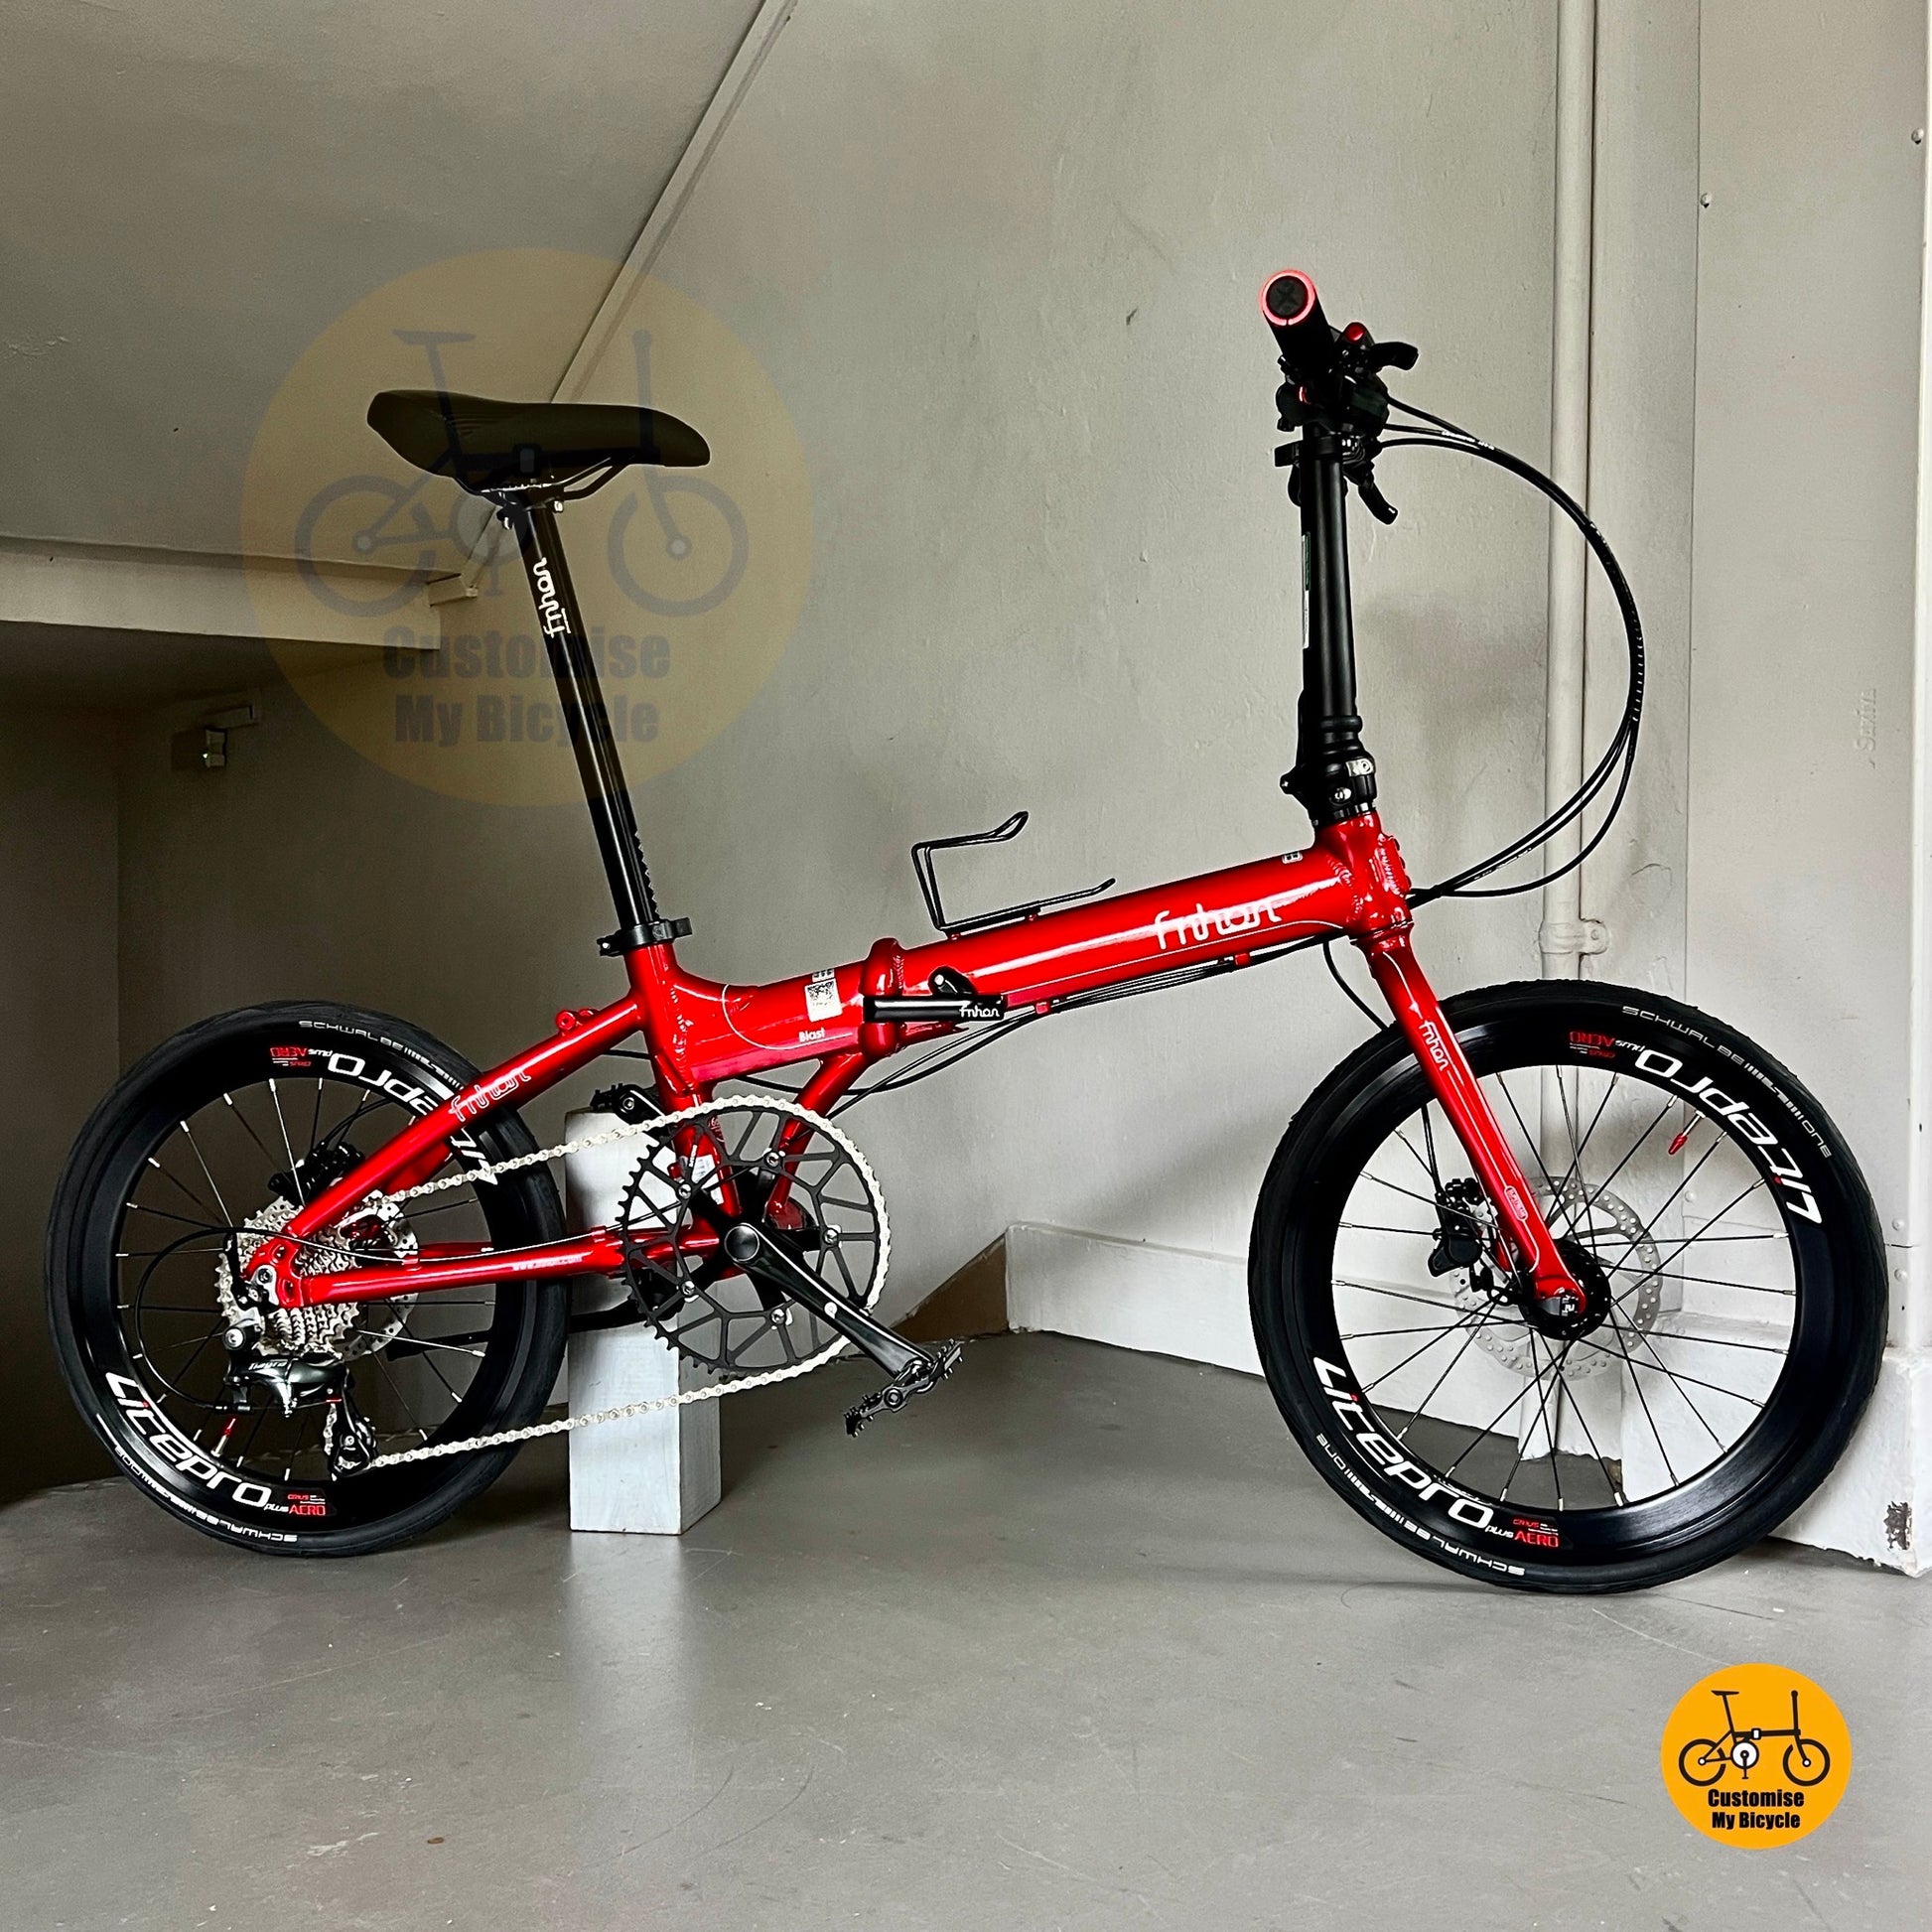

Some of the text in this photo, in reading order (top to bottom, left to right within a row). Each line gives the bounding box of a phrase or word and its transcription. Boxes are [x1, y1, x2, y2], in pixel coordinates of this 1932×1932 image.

[533, 557, 566, 638] fnhon
[299, 1021, 404, 1051] SCHWALBE
[798, 1027, 825, 1042] Blast
[1570, 1031, 1615, 1047] AERO
[1621, 1006, 1745, 1065] SCHWALBE
[270, 1046, 307, 1057] AERO
[288, 1504, 326, 1516] AERO
[196, 1510, 298, 1543] SCHWALBE
[1404, 1521, 1525, 1577] SCHWALBE
[1514, 1530, 1560, 1548] AERO
